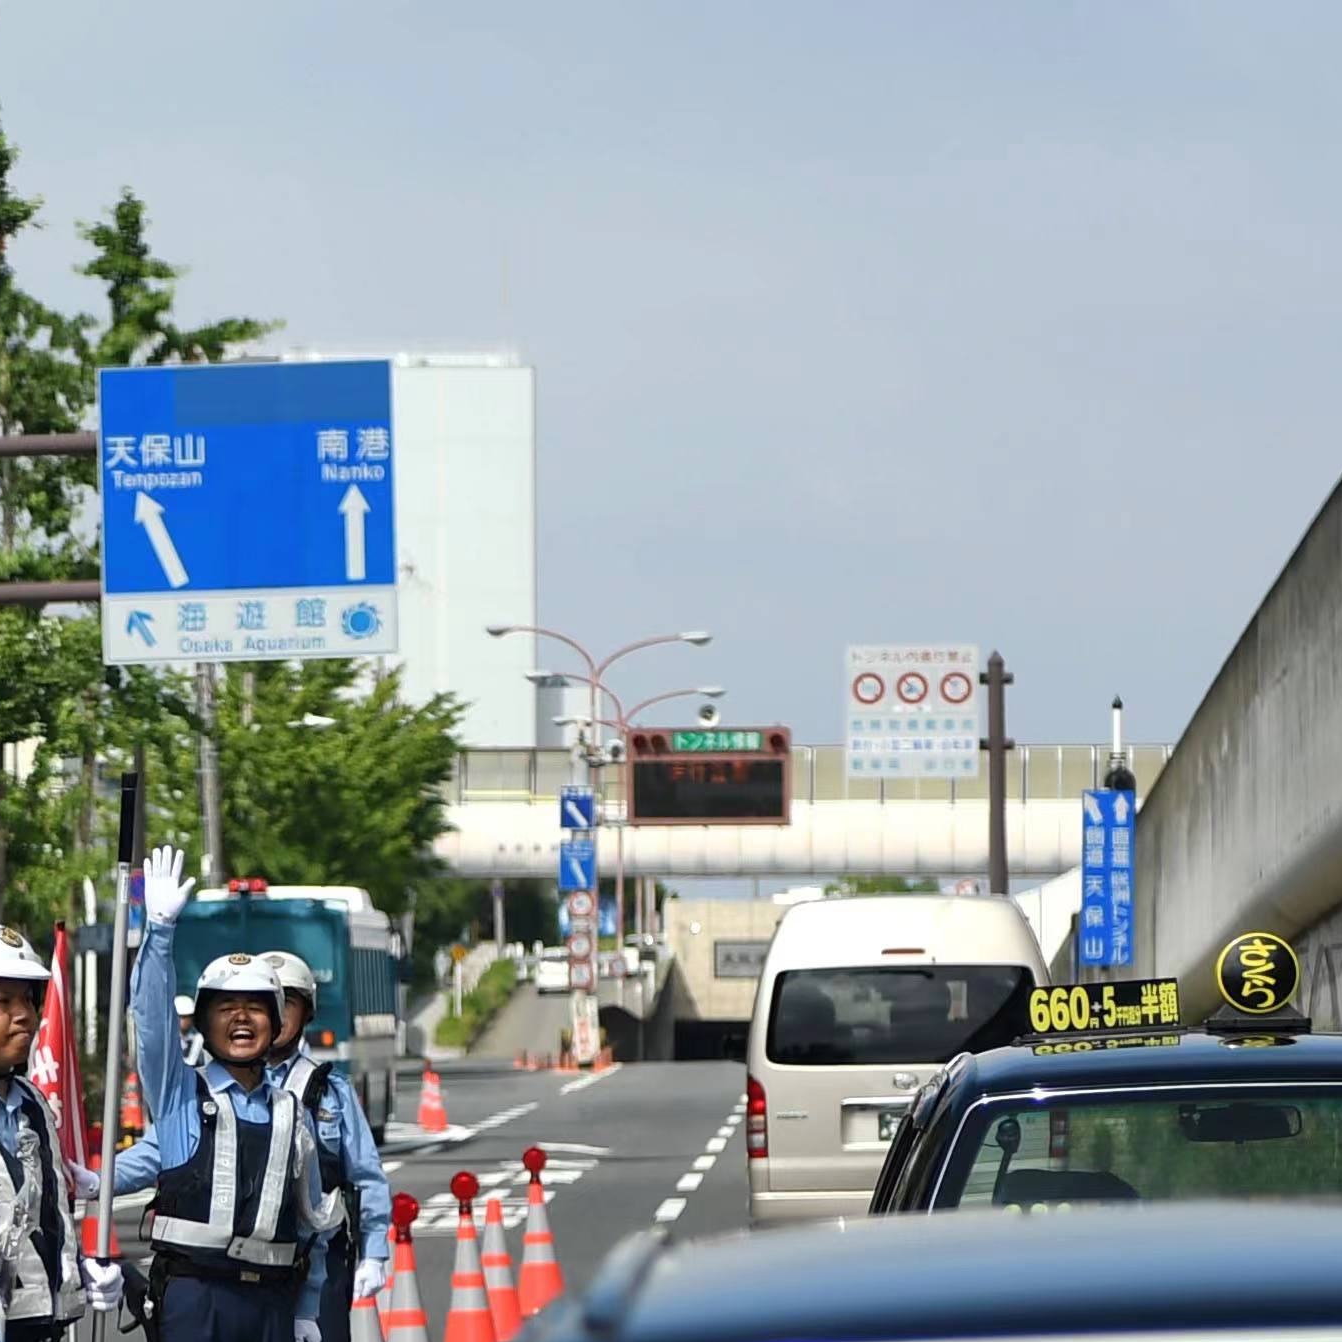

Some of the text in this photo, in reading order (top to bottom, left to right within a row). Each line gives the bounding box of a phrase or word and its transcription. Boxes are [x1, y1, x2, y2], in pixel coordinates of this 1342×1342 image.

[104, 433, 206, 469] 天保山
[316, 428, 390, 461] 南港
[178, 598, 328, 632] 海遊館
[179, 634, 327, 654] Osaka Aquarium
[1239, 938, 1277, 1008] さくら
